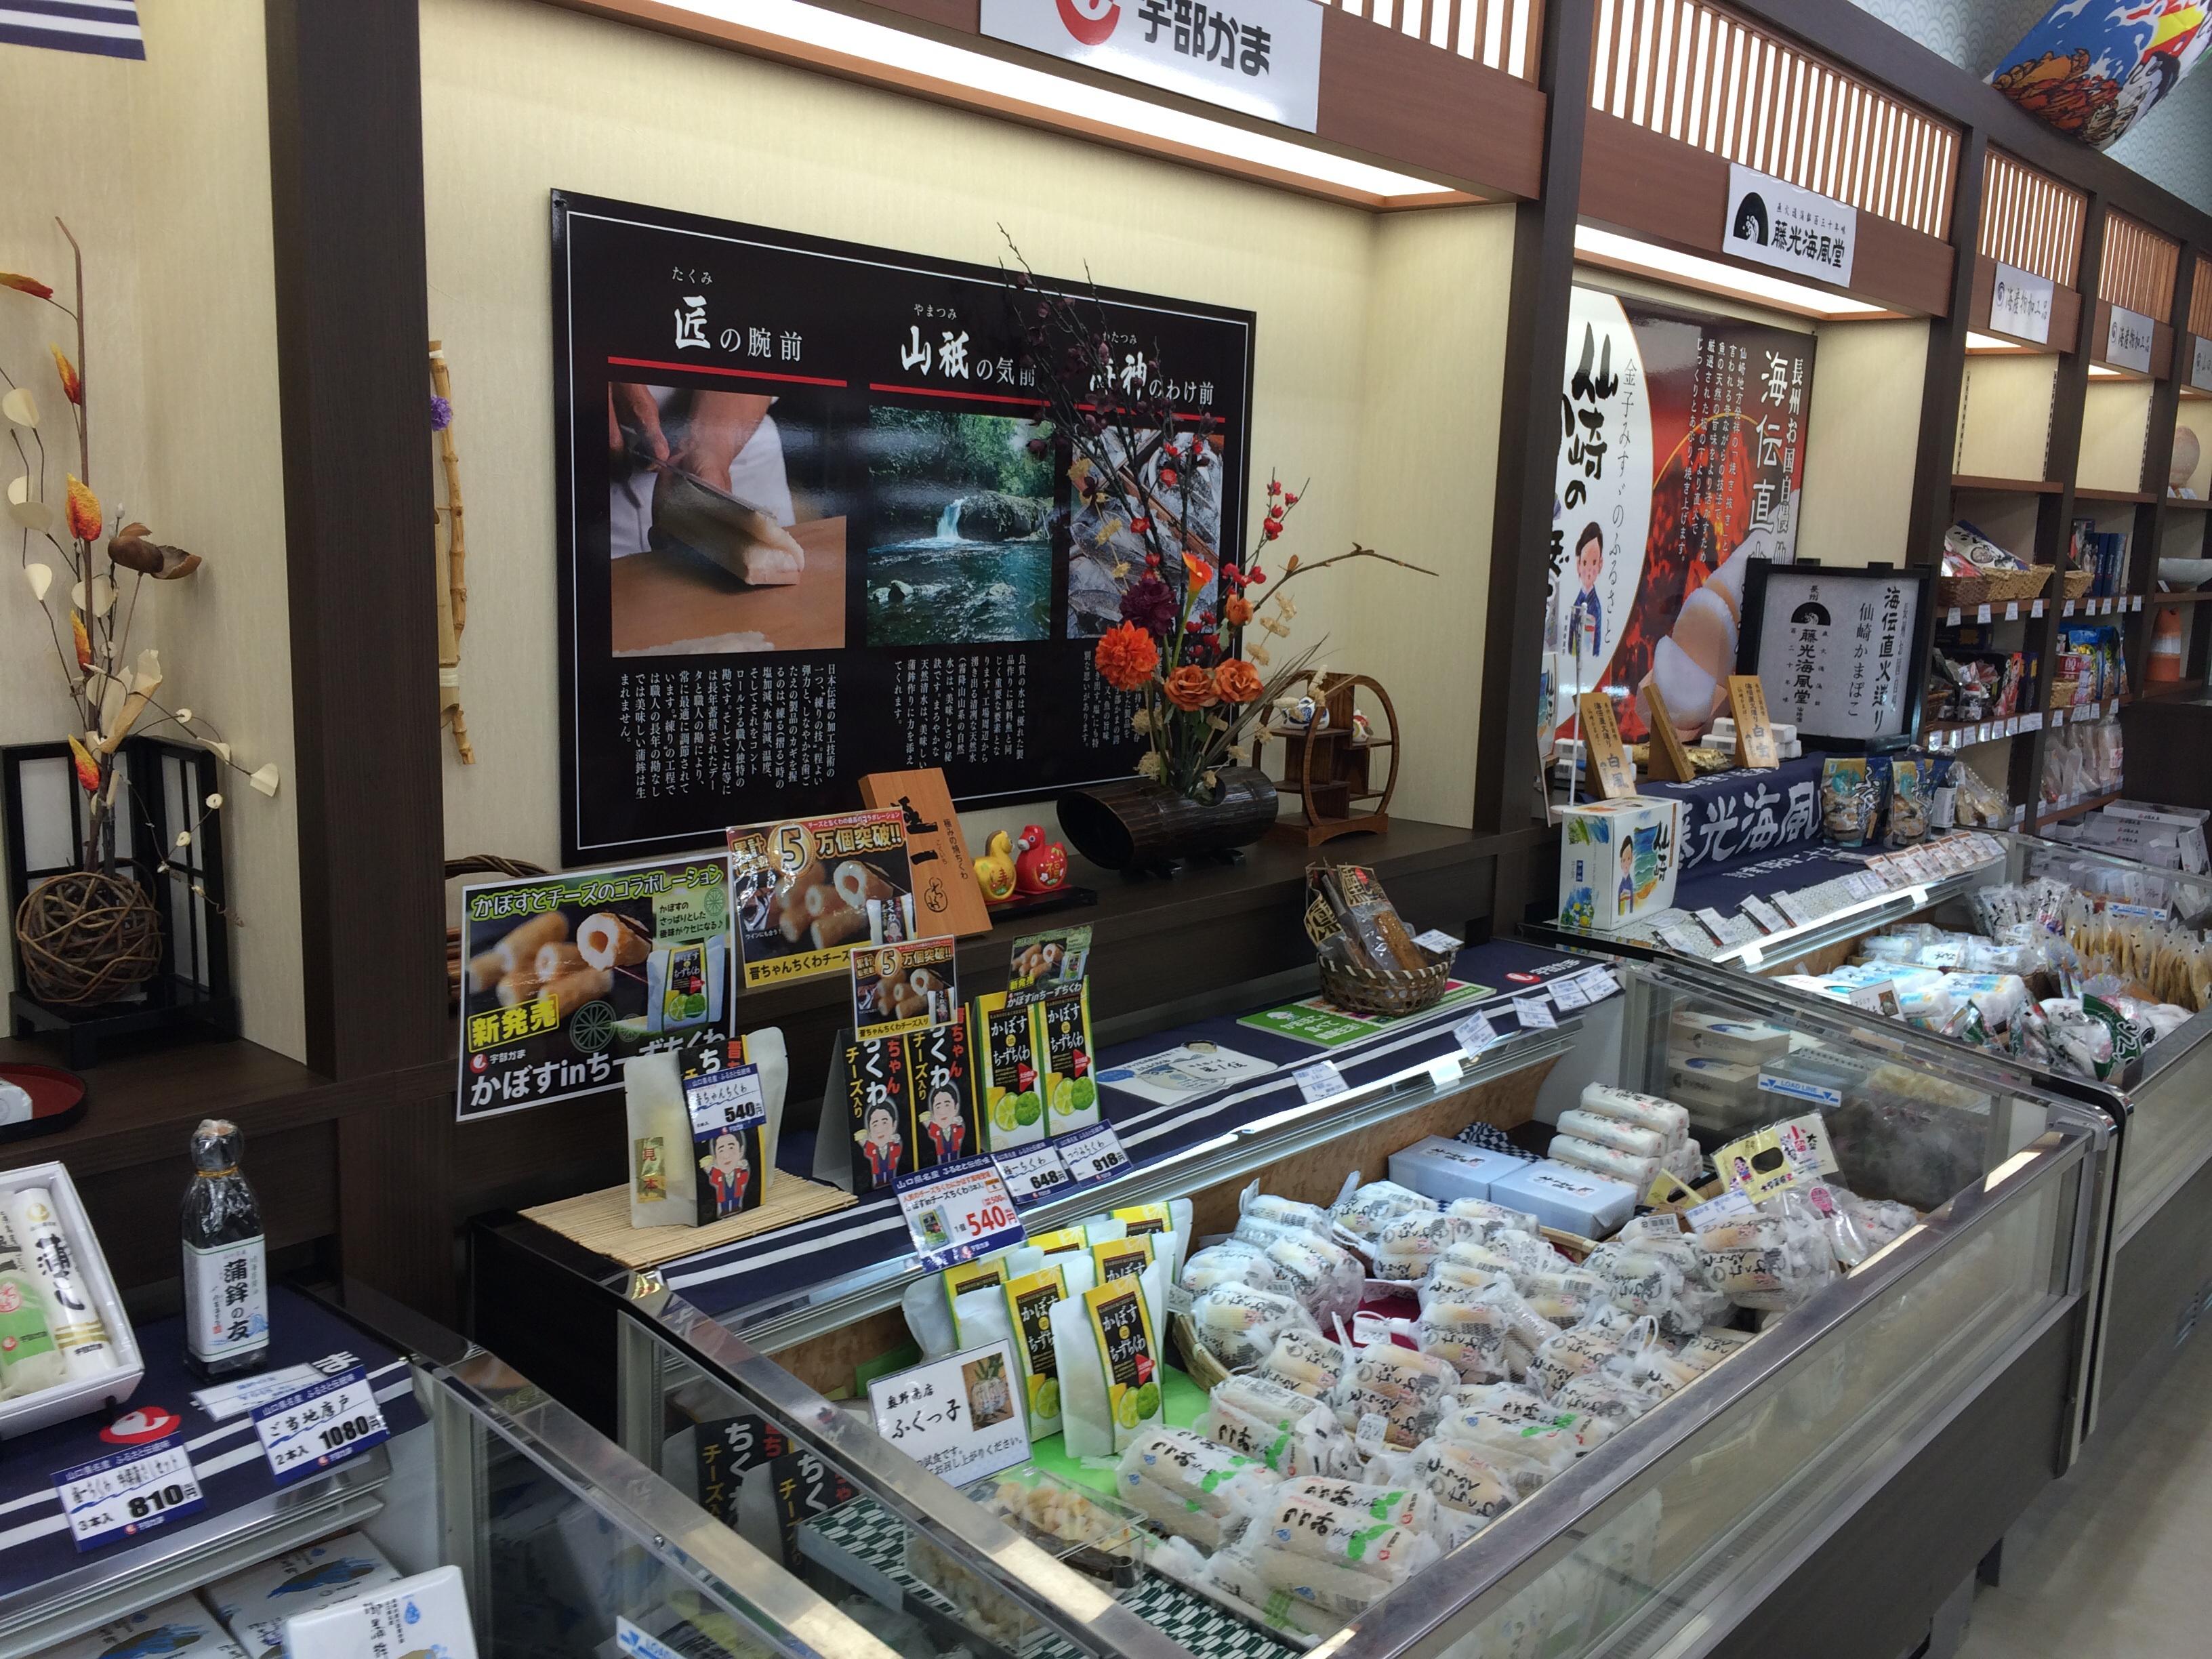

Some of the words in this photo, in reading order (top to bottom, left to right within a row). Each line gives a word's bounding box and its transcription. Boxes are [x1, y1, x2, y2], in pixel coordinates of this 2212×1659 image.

[672, 266, 714, 285] たくみ
[674, 294, 803, 364] 匠の腕前
[914, 303, 958, 321] やまつみ
[1793, 628, 1818, 705] 藤光海風堂
[1848, 602, 1874, 717] 仙崎かまぼこ
[619, 674, 632, 743] まれません。
[893, 660, 903, 725] てくれます。
[1679, 781, 1822, 869] 光海風
[781, 827, 805, 872] 5
[473, 865, 723, 918] かぼすとチーズのコラボレーション
[658, 901, 689, 914] かぼすの
[882, 951, 897, 975] 5
[472, 998, 557, 1048] 新発売
[991, 1016, 1028, 1037] かぼす
[1047, 1003, 1081, 1024] かぼす
[489, 1048, 527, 1065] 宇部かま
[886, 1035, 901, 1096] ちゃん
[844, 1046, 864, 1120] チーズ入り
[222, 1258, 250, 1343] 蒲鉾の友
[1102, 1303, 1139, 1332] かぼす
[891, 1398, 961, 1440] ふくっ子
[274, 1445, 310, 1466] 2本入
